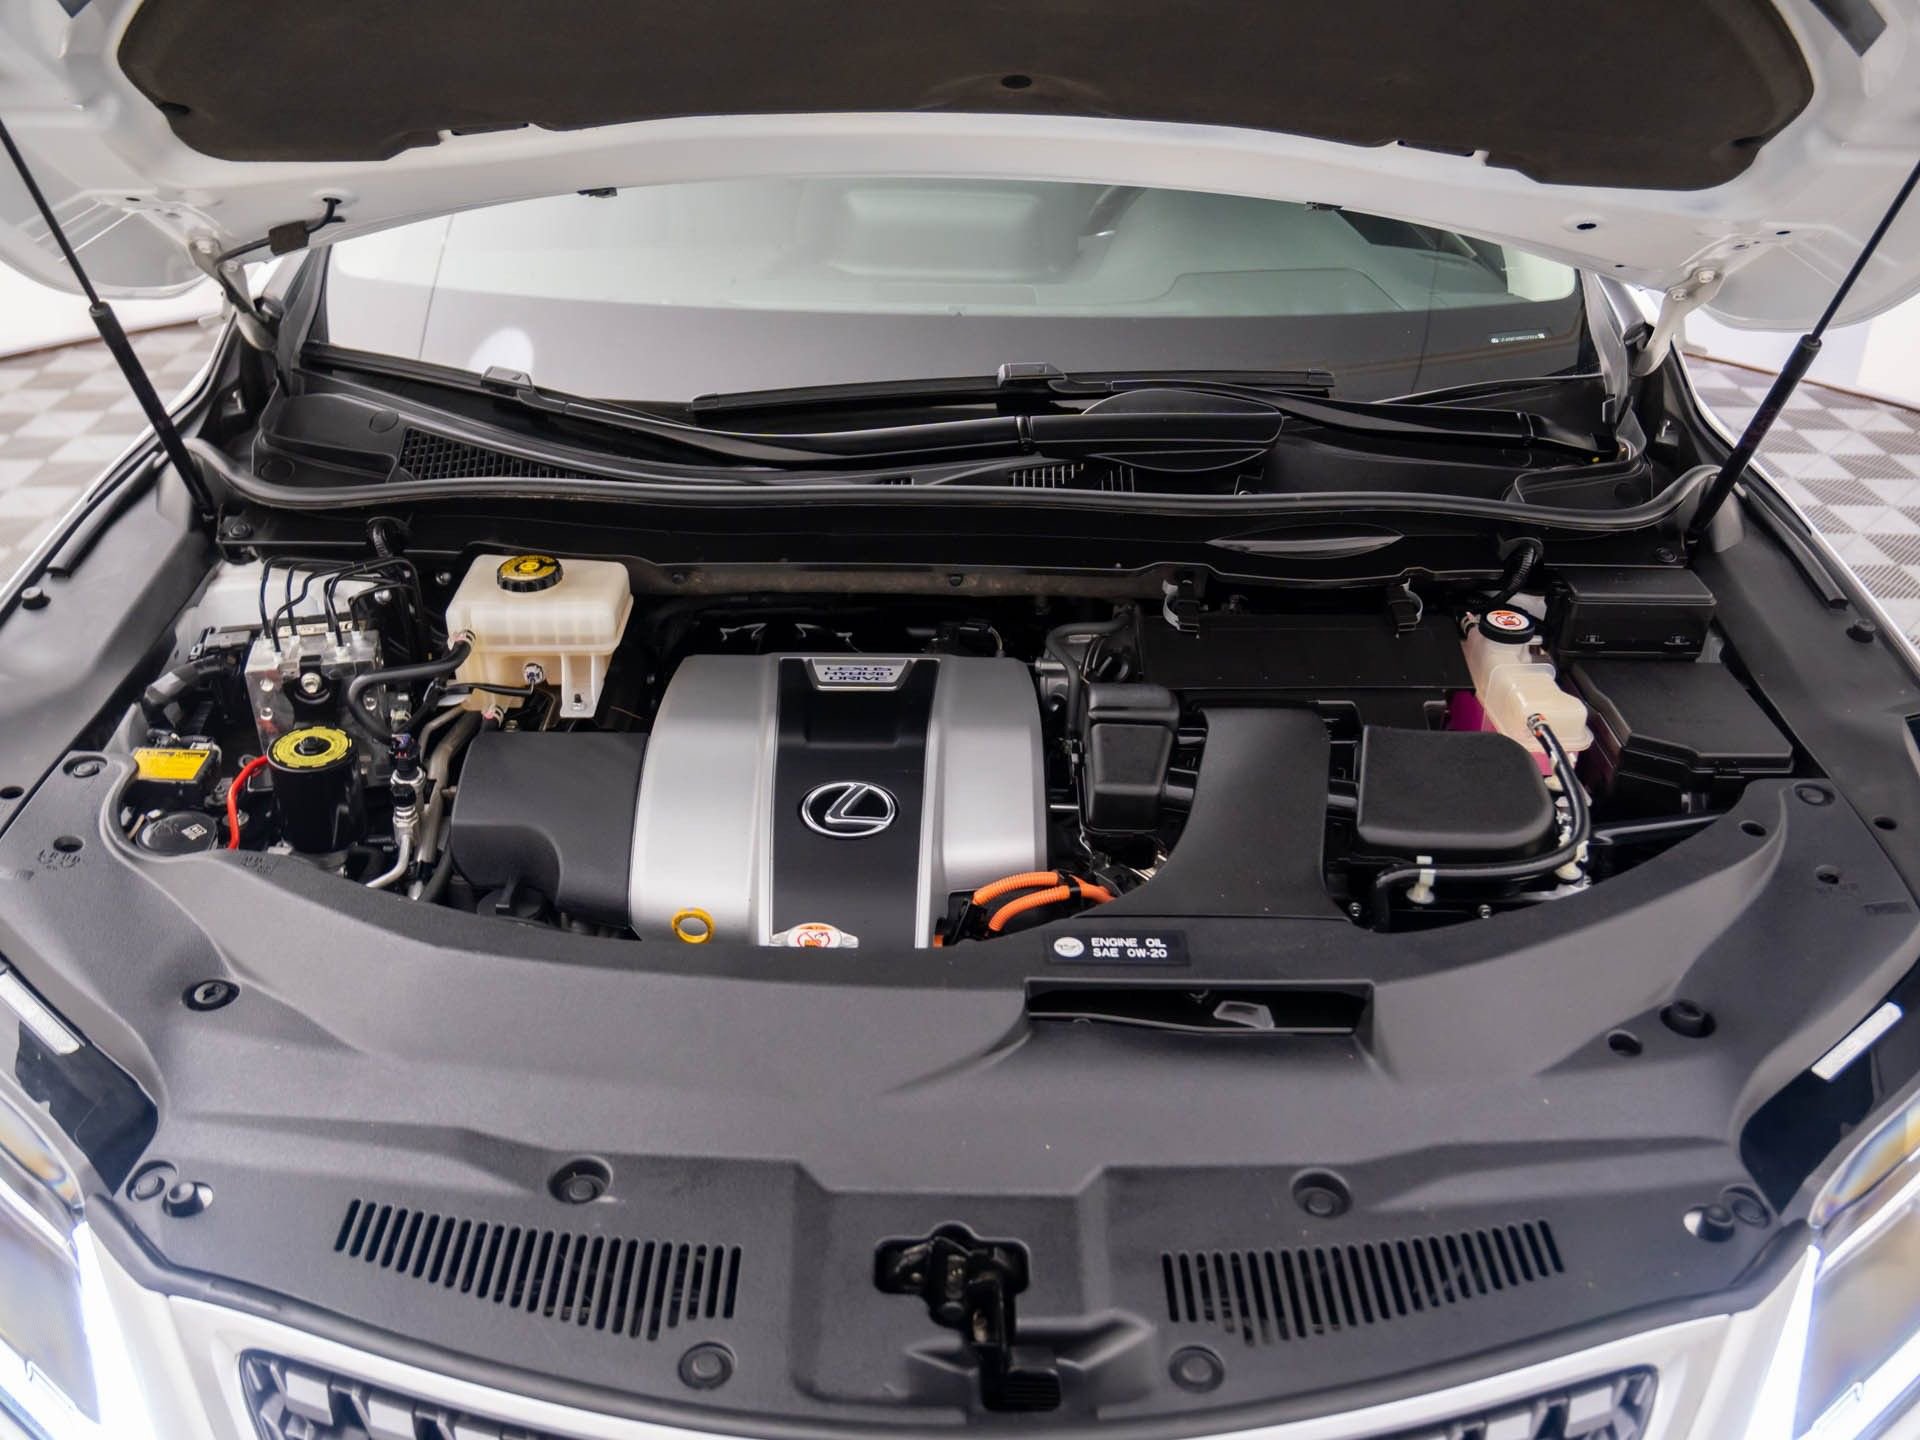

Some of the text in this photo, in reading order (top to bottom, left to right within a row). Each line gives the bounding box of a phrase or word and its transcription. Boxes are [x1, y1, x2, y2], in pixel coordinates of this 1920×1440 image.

[1091, 937, 1167, 948] ENGINE OIL
[1093, 948, 1168, 958] SAE 0W-20
